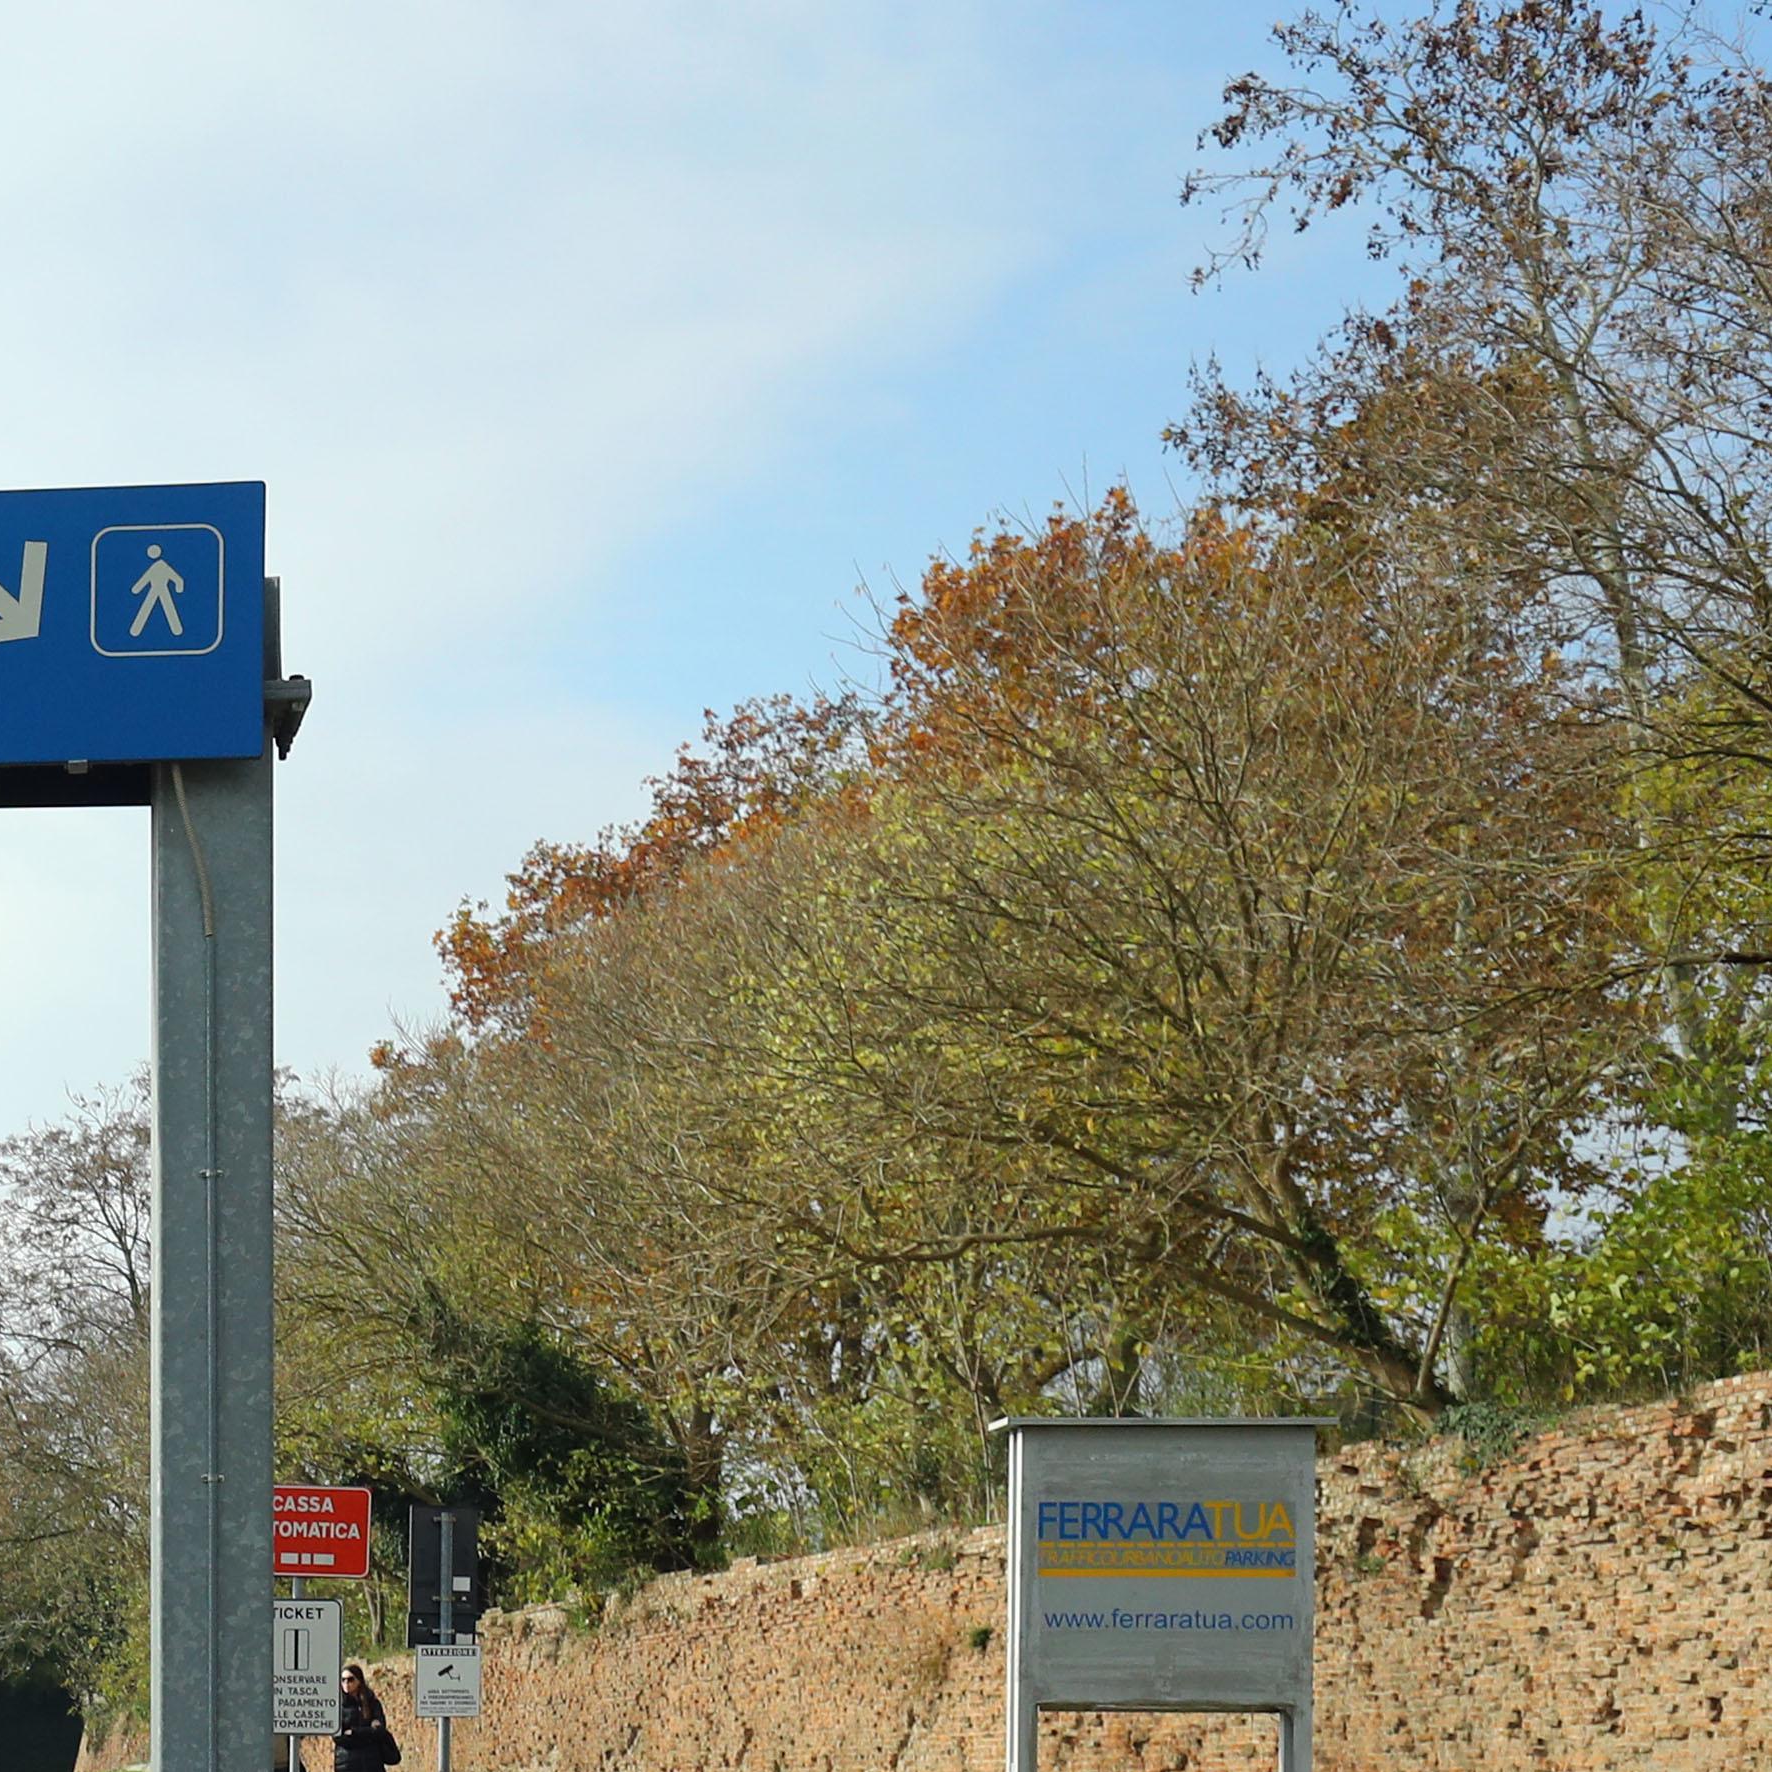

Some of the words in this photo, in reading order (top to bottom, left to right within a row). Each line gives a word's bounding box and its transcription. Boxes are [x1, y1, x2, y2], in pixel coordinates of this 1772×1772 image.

[272, 1495, 334, 1513] CASSA
[1038, 1501, 1296, 1541] FERRARATUA
[272, 1520, 361, 1539] TOMATICA
[273, 1607, 324, 1619] TICKET
[1044, 1608, 1294, 1631] www.ferraratua.com
[273, 1675, 327, 1684] ONSERVARE
[288, 1687, 319, 1695] TASCA
[278, 1698, 336, 1707] PAGAMENTO
[294, 1710, 326, 1719] CASSE
[274, 1720, 334, 1729] TOMATICHE
